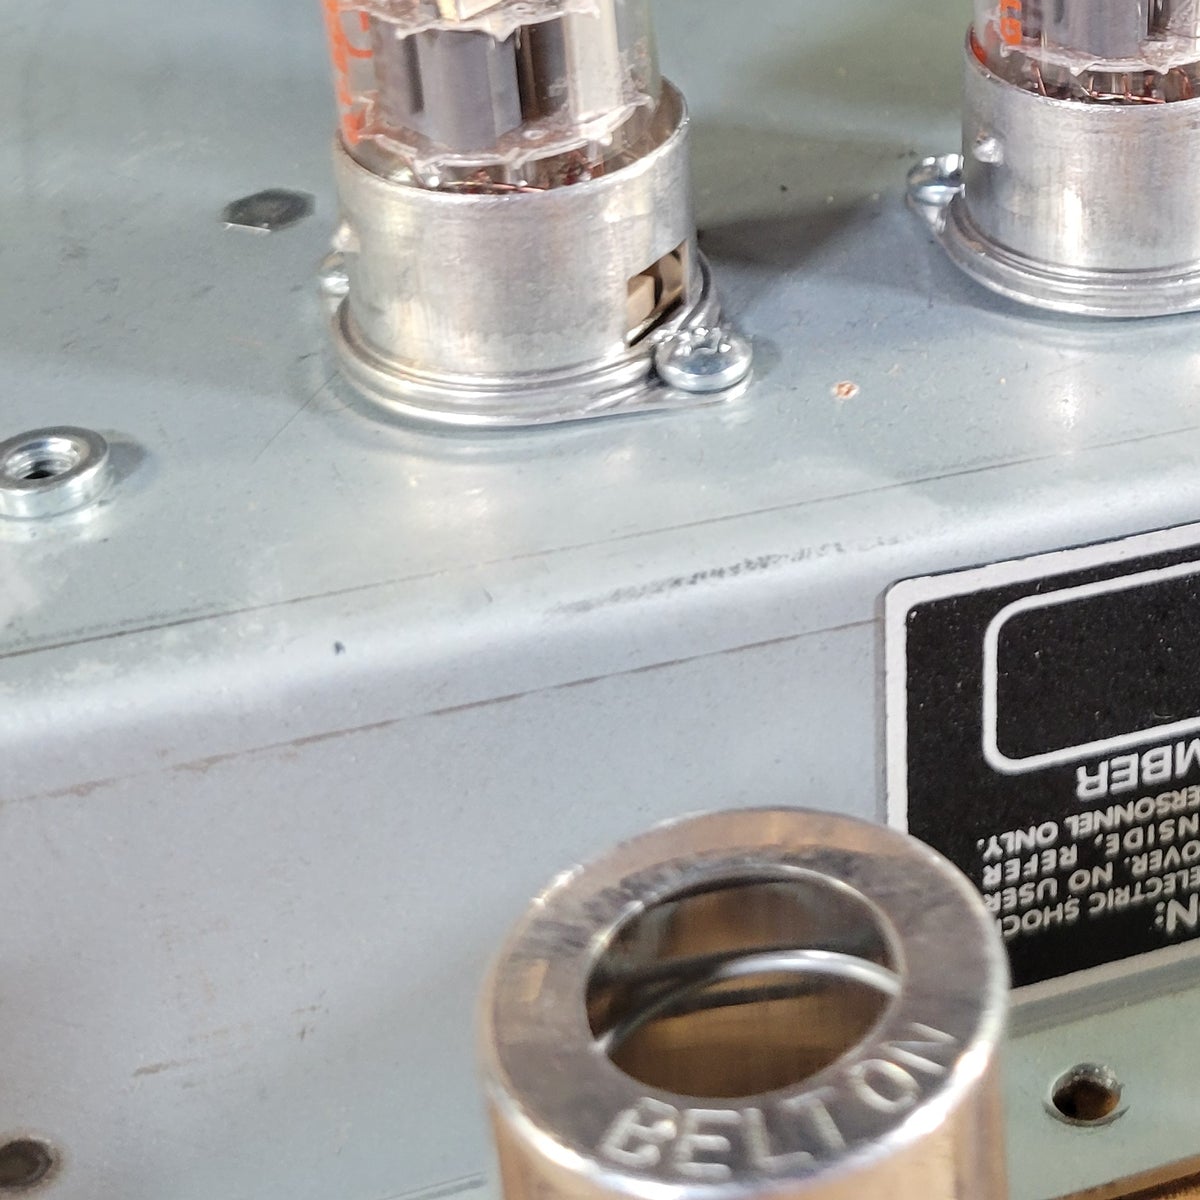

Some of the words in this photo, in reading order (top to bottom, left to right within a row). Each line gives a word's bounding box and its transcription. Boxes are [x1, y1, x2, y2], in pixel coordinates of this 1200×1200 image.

[977, 821, 1059, 862] ONLY.
[982, 843, 1078, 889] REFER
[1068, 862, 1113, 892] NO
[983, 878, 1058, 912] USER
[602, 1021, 958, 1181] BELTON
